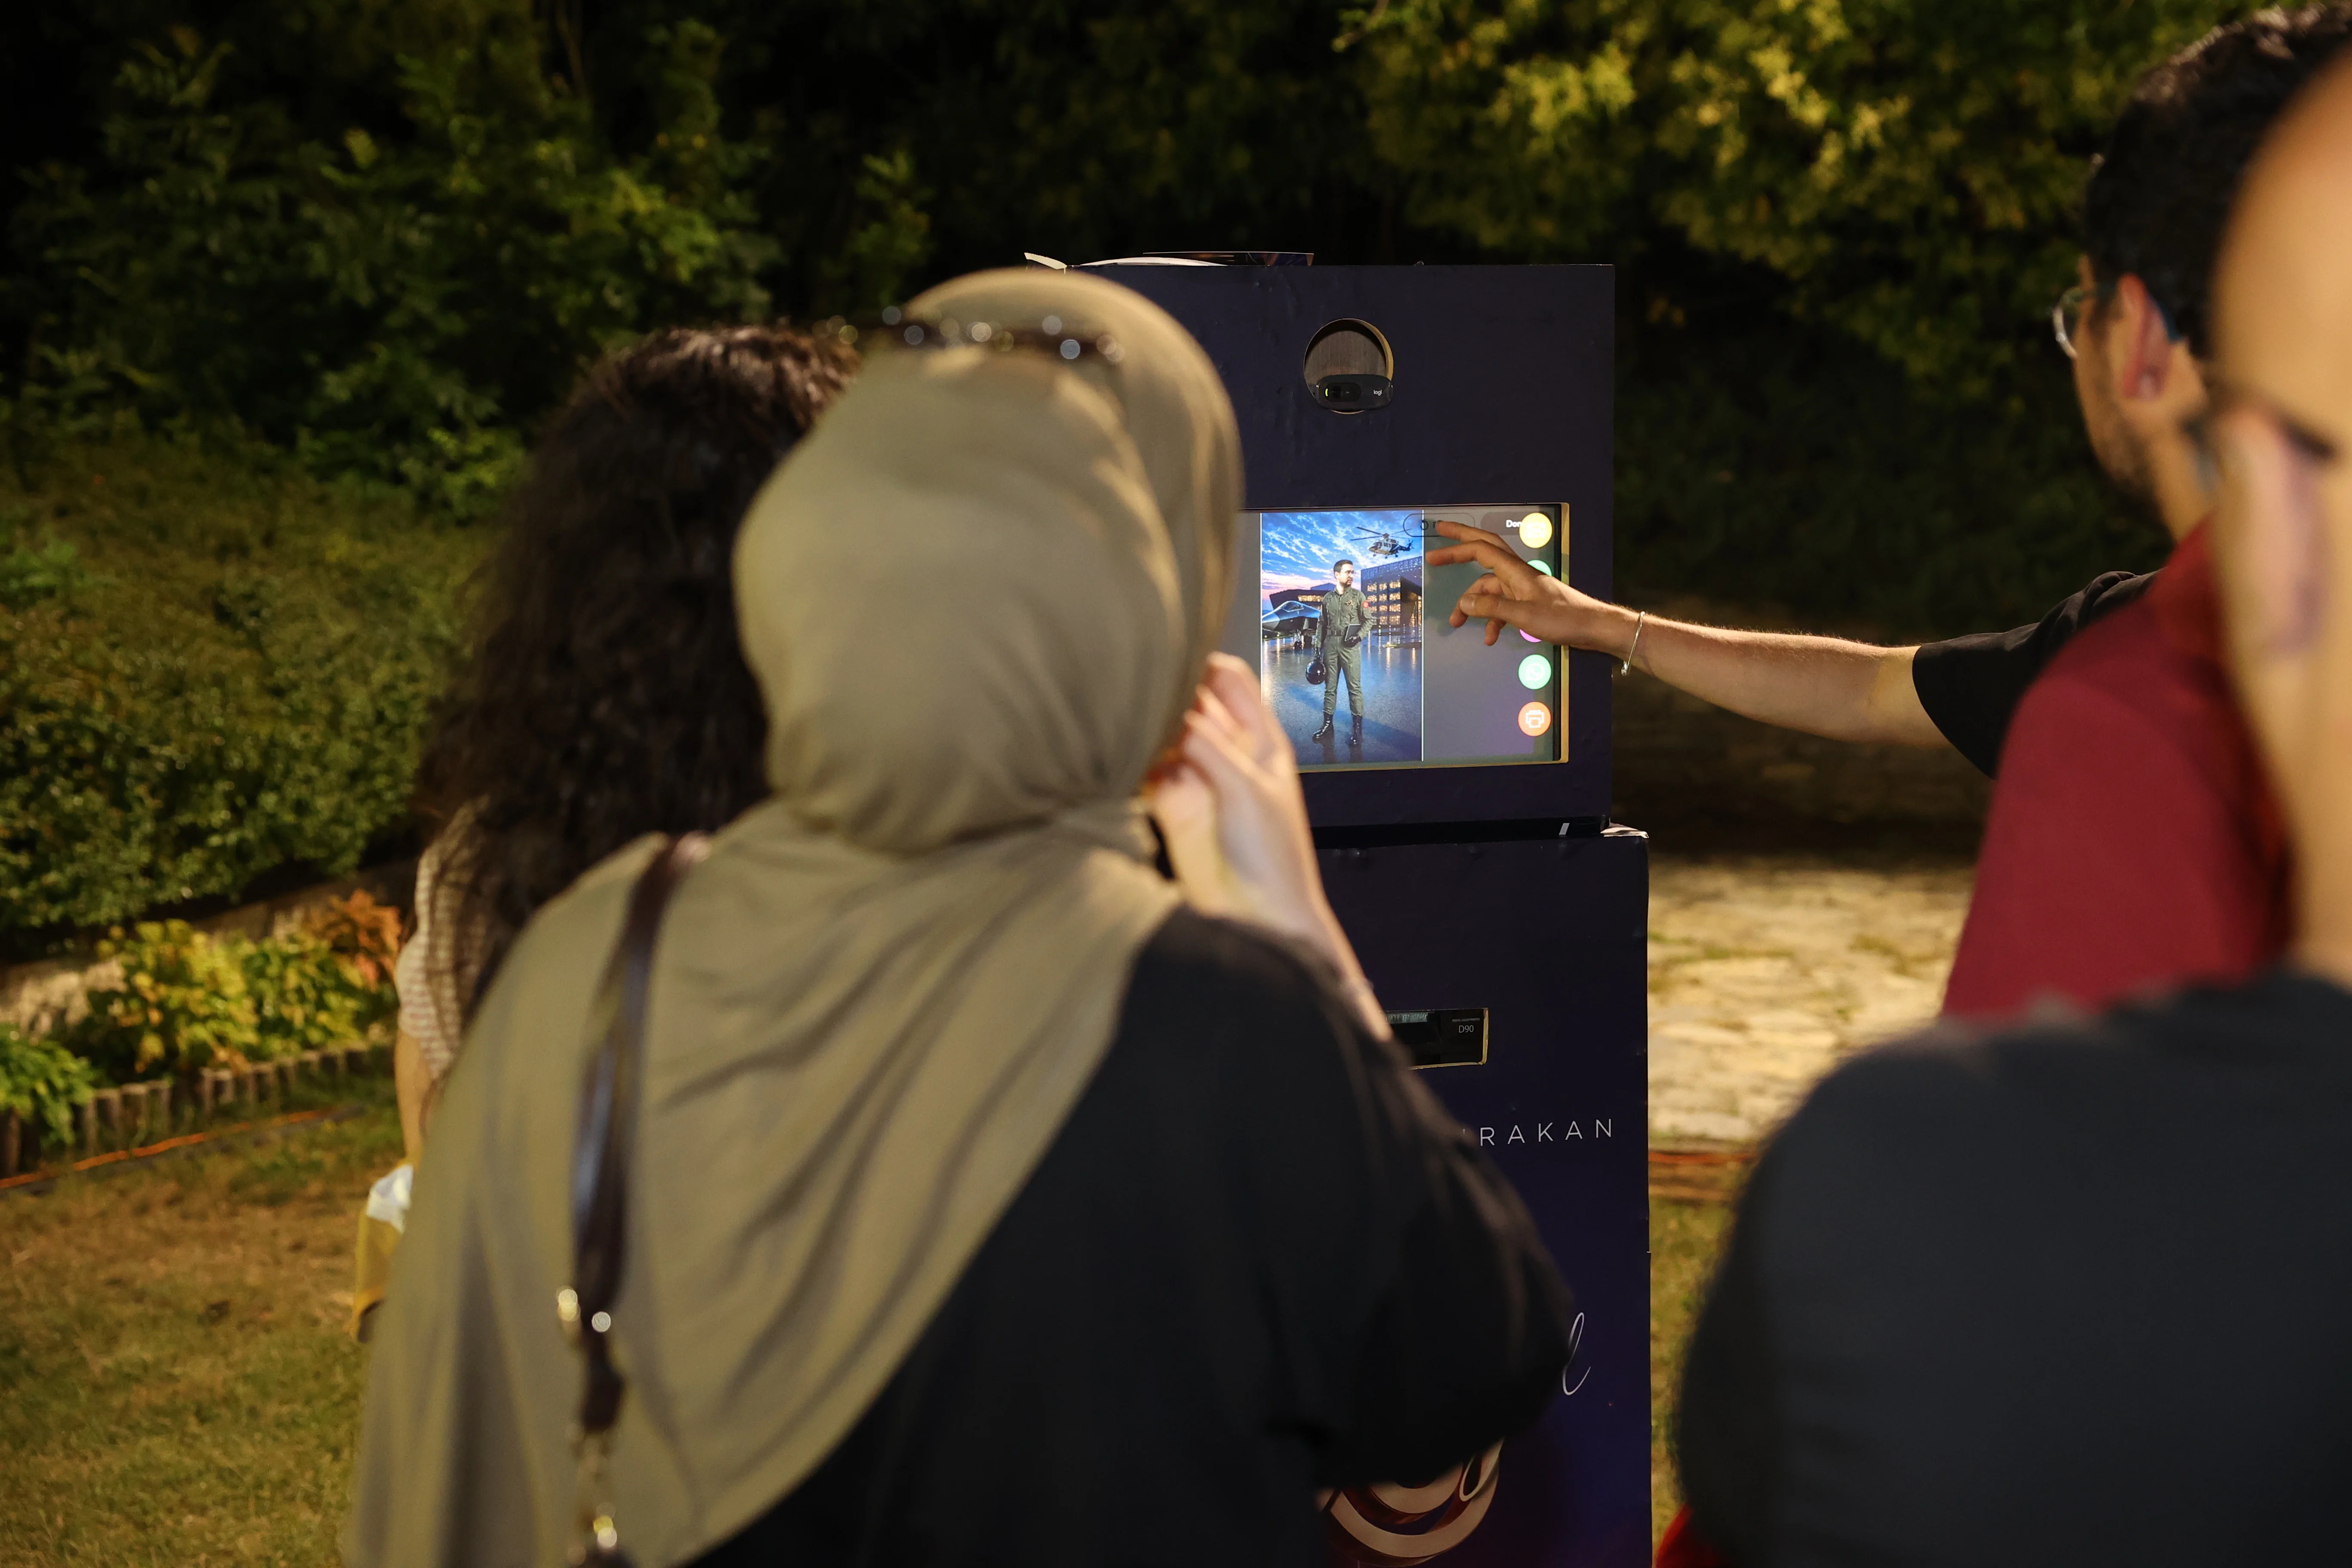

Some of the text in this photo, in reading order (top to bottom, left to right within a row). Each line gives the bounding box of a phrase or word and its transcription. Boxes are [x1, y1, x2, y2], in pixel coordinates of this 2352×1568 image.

[1506, 519, 1522, 528] Don
[1459, 1025, 1474, 1033] D90
[1462, 1118, 1612, 1147] RAKAN
